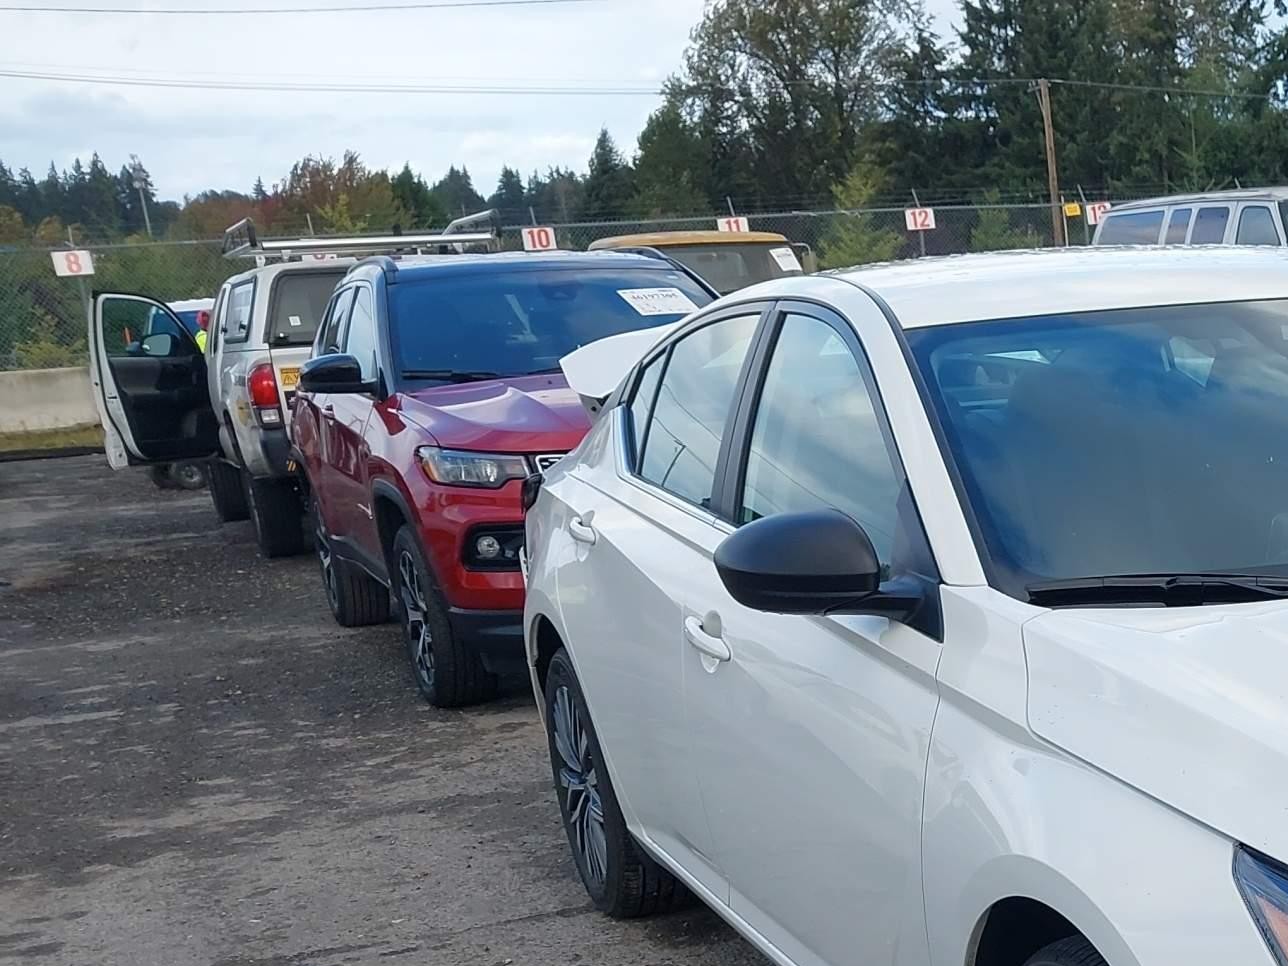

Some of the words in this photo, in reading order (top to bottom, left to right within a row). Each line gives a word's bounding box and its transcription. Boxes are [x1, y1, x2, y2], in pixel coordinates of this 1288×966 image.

[725, 219, 741, 232] 11
[910, 210, 930, 228] 12
[527, 229, 551, 249] 10
[65, 252, 81, 273] 8
